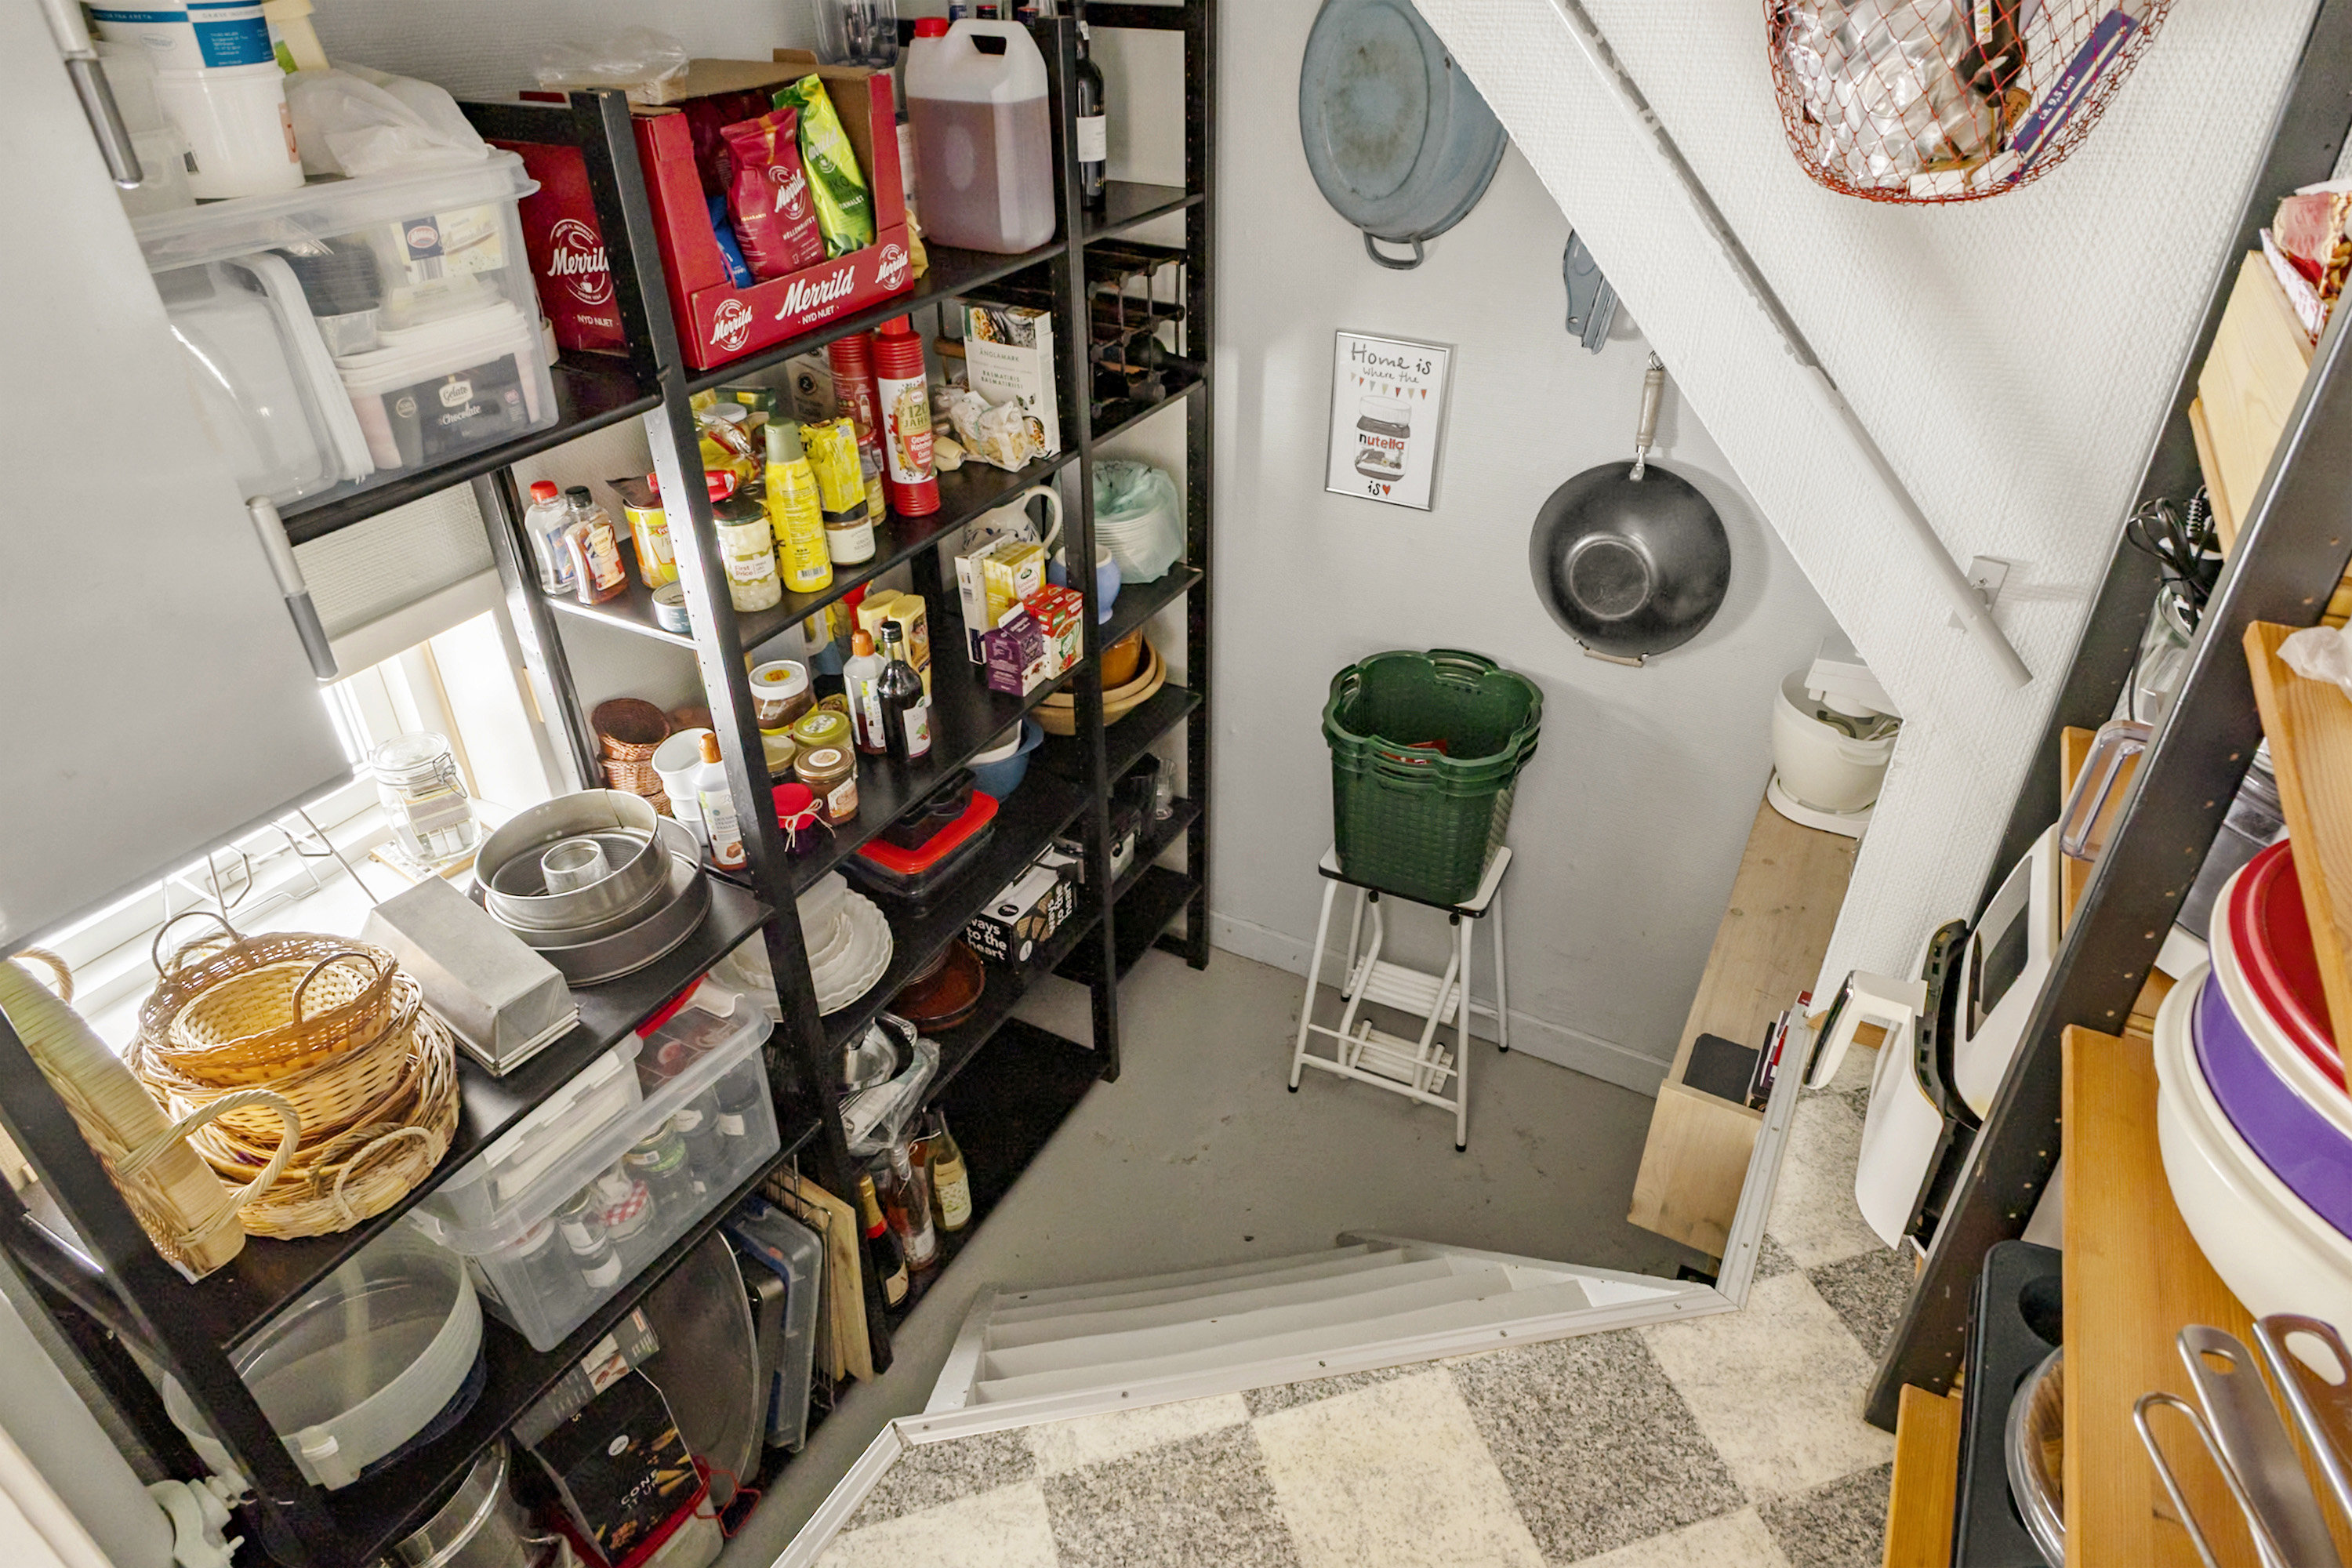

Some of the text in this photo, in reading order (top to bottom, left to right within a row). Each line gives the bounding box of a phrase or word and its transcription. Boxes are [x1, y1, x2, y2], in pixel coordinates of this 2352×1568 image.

[2049, 89, 2064, 104] 9,5
[774, 169, 807, 213] Merrild
[874, 250, 909, 284] Merrild
[775, 265, 855, 321] Merrild
[576, 314, 614, 328] NYD NUET
[709, 305, 753, 345] Merrild
[801, 305, 835, 325] NYD NUET
[1351, 341, 1432, 375] Home is
[1399, 370, 1420, 383] the
[441, 401, 482, 425] Chocolate
[909, 401, 928, 418] 120
[1359, 433, 1406, 451] nutella
[1367, 481, 1381, 495] is
[1054, 884, 1064, 909] the
[1064, 880, 1073, 919] heart
[966, 927, 1007, 951] to the
[968, 936, 1006, 961] heart
[621, 1468, 659, 1505] CONE
